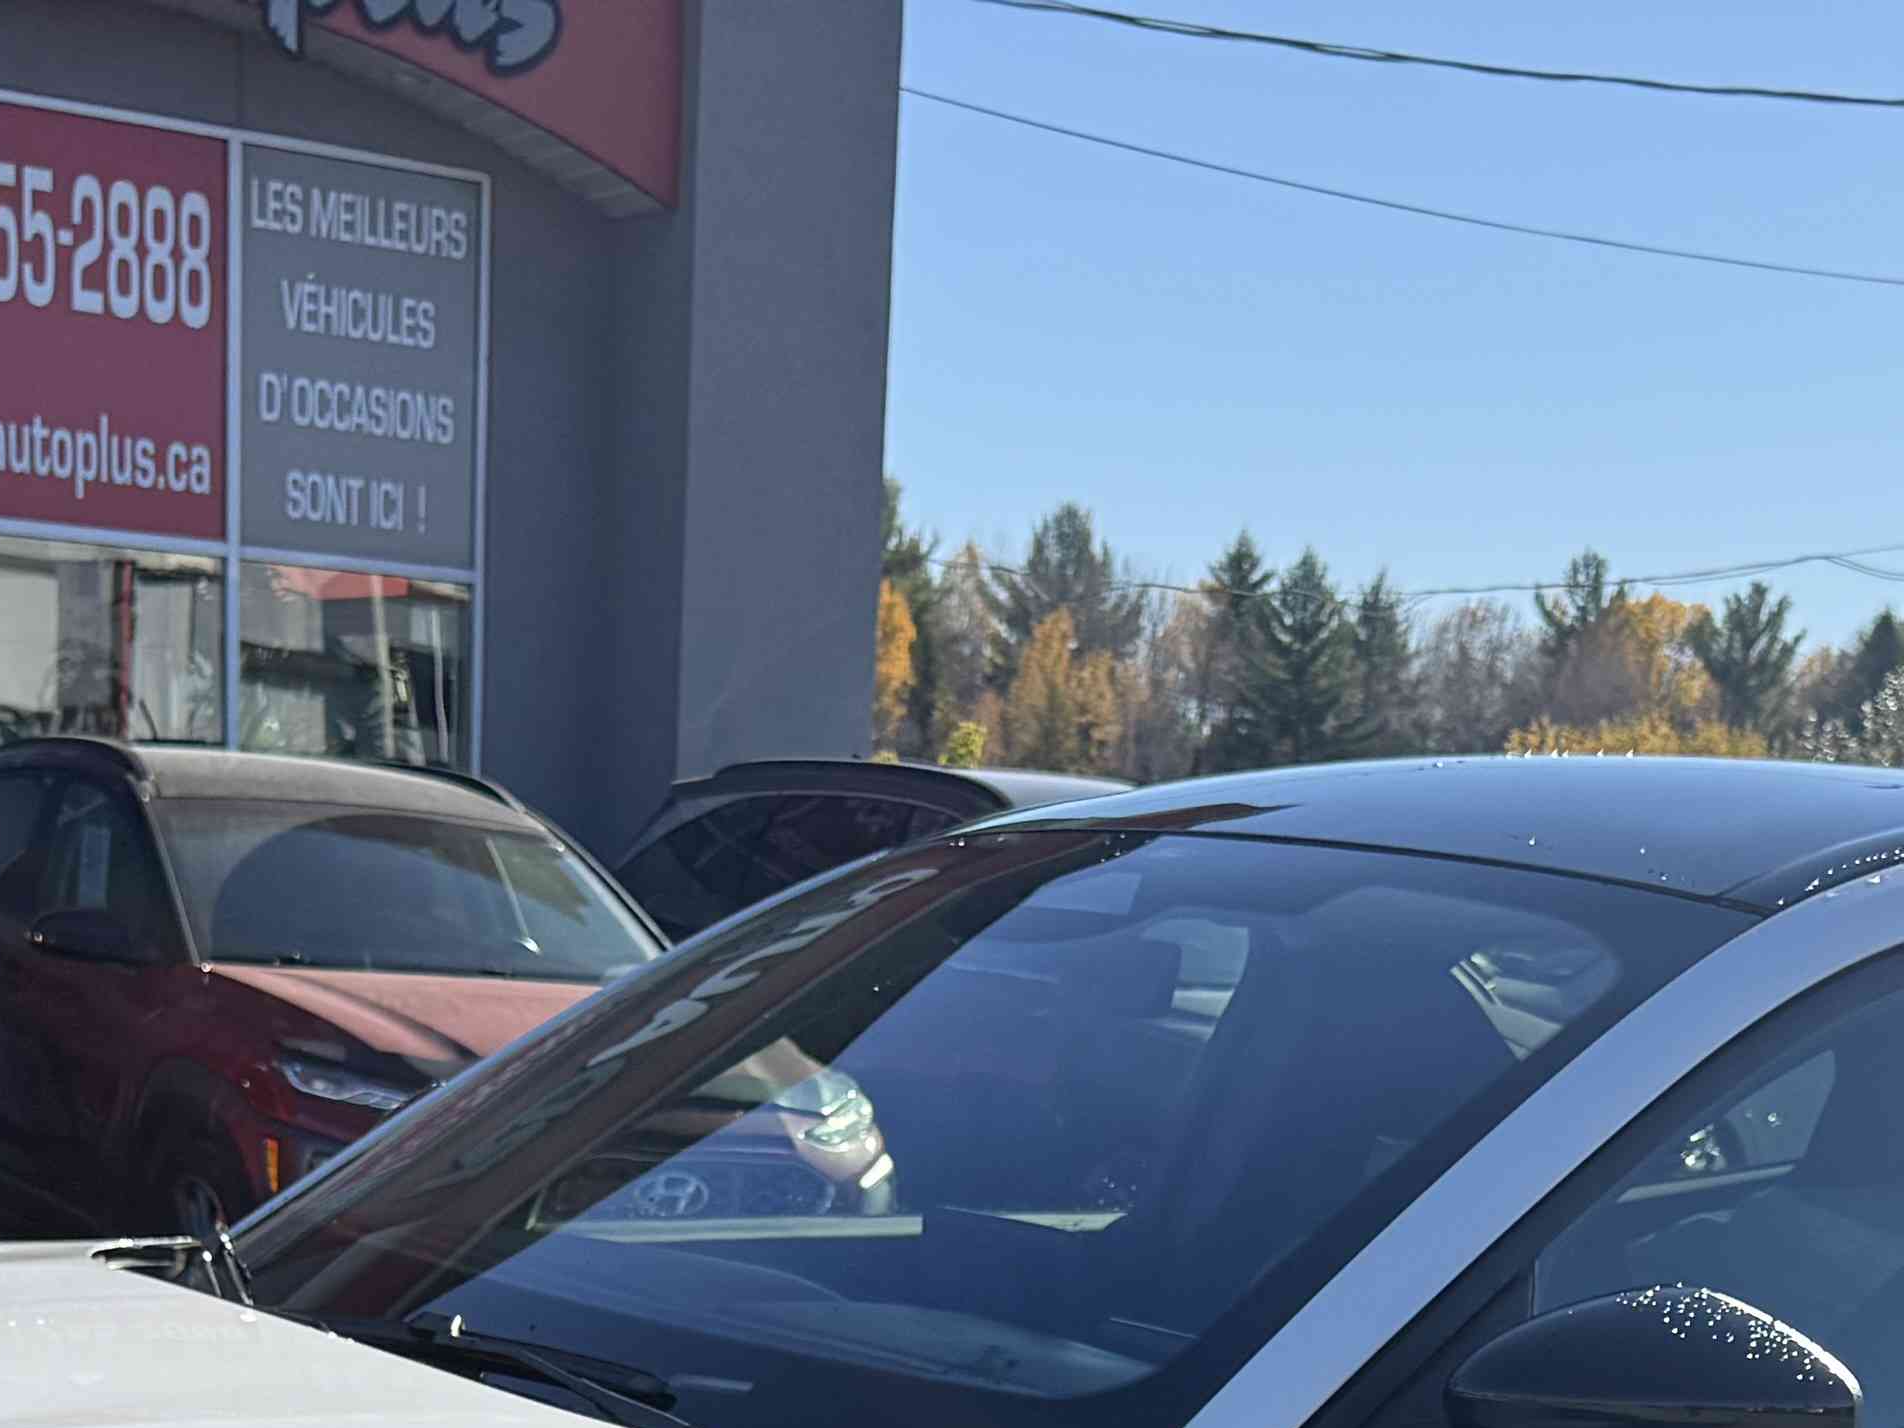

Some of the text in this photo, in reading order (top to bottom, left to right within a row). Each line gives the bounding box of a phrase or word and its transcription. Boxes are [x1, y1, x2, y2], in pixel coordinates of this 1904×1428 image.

[251, 176, 468, 260] LES MEILLEURS
[280, 273, 436, 349] VÉHICULES
[285, 469, 428, 534] SONT ICI !
